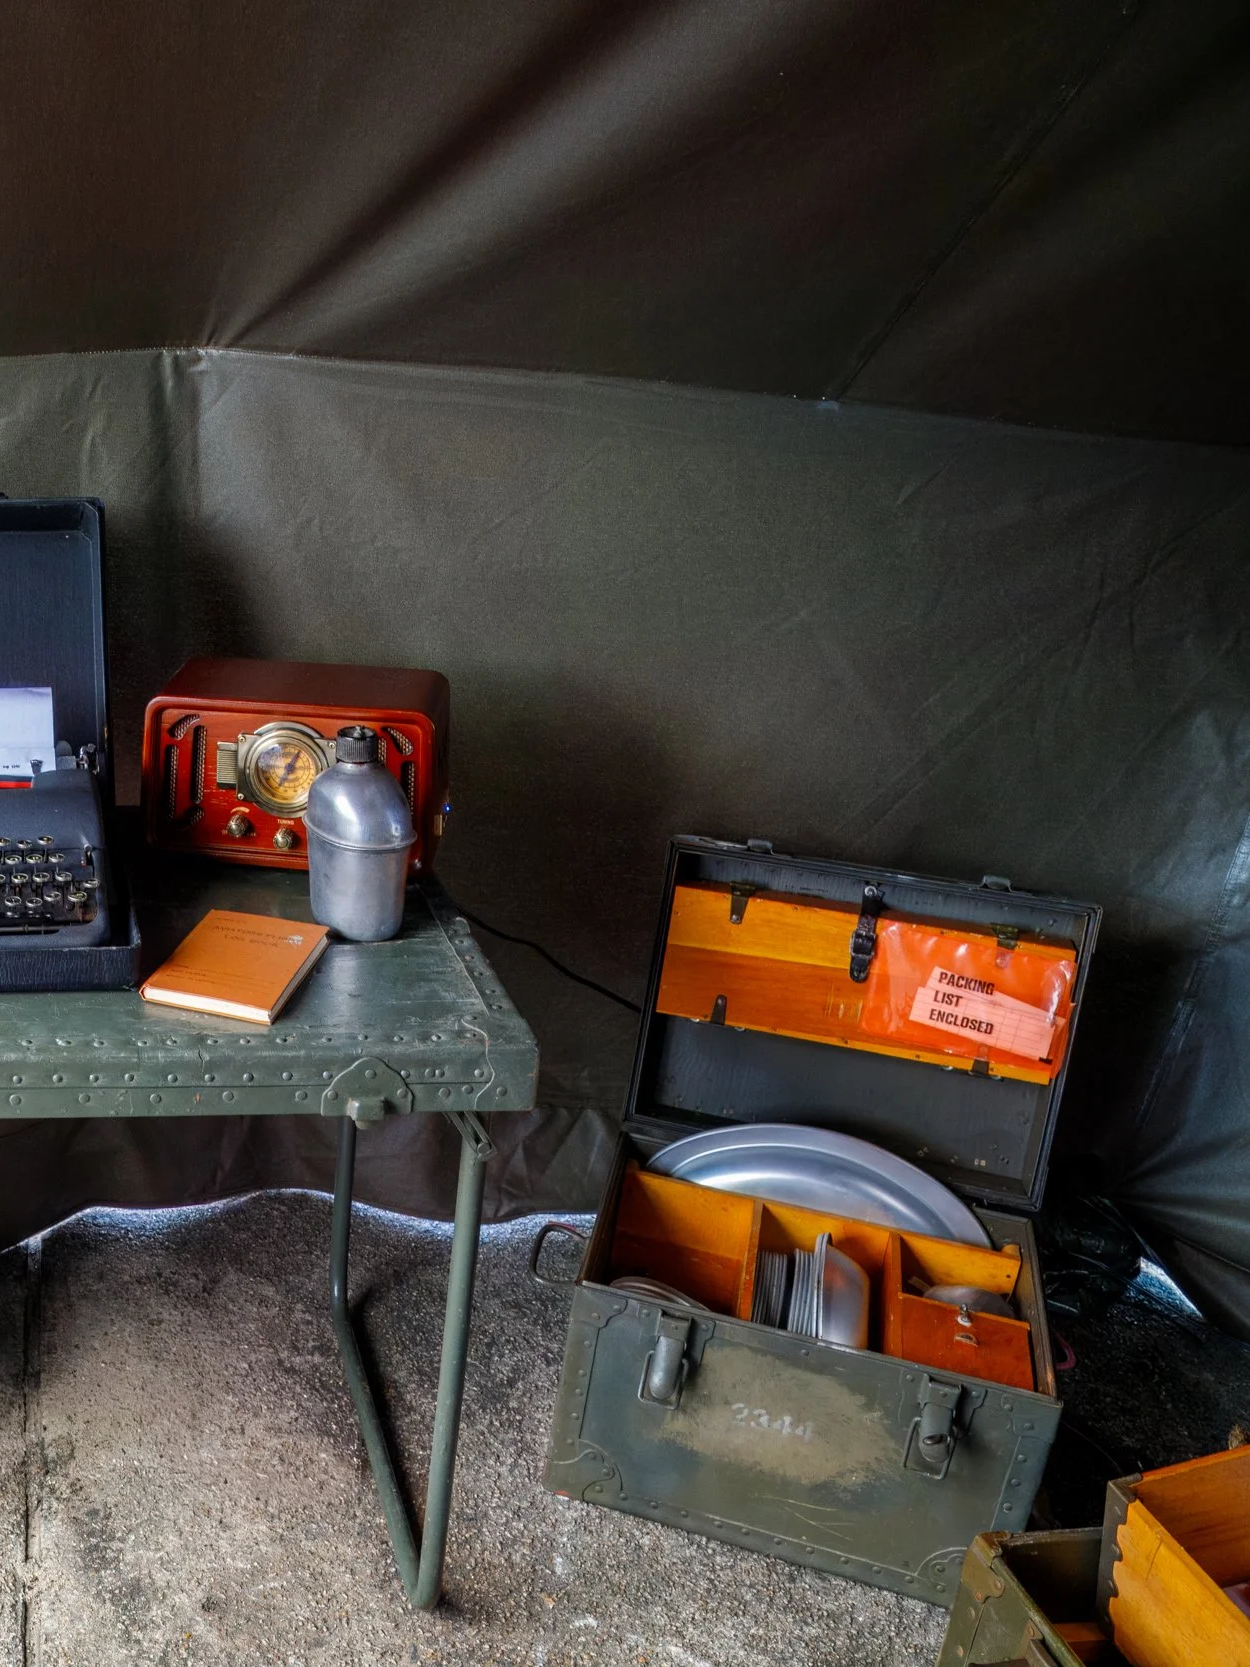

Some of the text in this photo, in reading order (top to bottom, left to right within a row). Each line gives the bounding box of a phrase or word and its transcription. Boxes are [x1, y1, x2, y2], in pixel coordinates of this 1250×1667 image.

[938, 971, 995, 996] PACKING
[933, 990, 963, 1007] LIST
[929, 1008, 994, 1035] ENCLOSED
